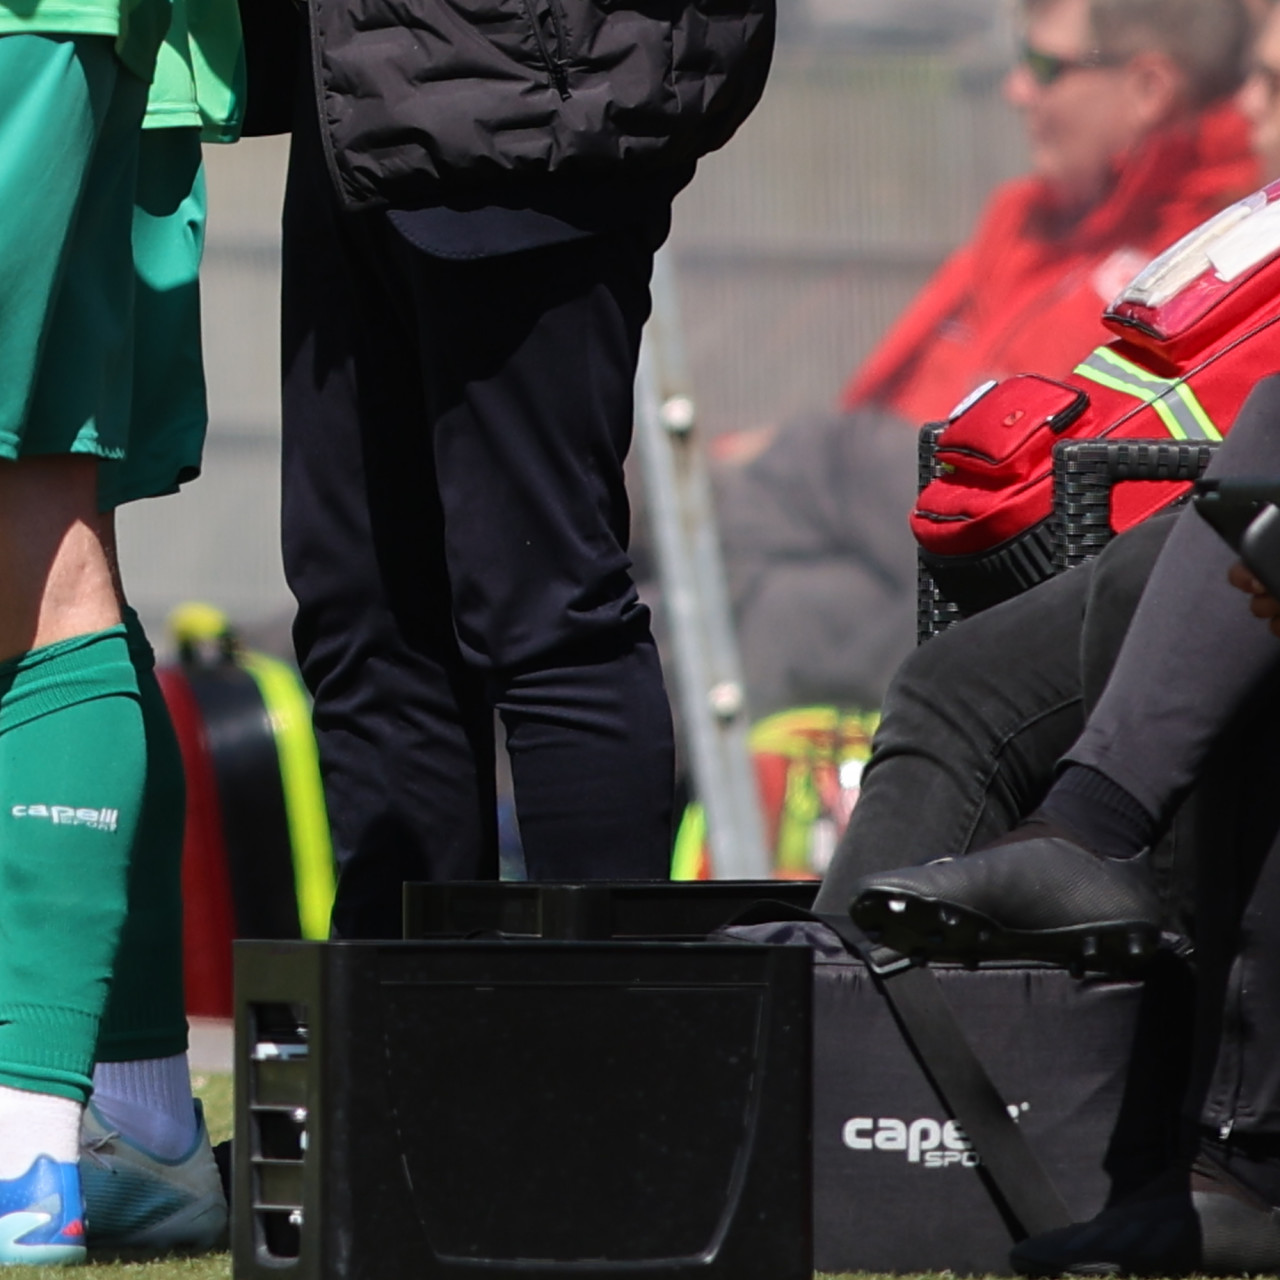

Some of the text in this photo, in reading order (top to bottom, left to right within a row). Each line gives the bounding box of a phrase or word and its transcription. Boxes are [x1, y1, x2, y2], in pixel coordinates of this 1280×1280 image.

[11, 804, 118, 824] capelli
[843, 1117, 973, 1162] cape
[924, 1151, 979, 1167] SPO
